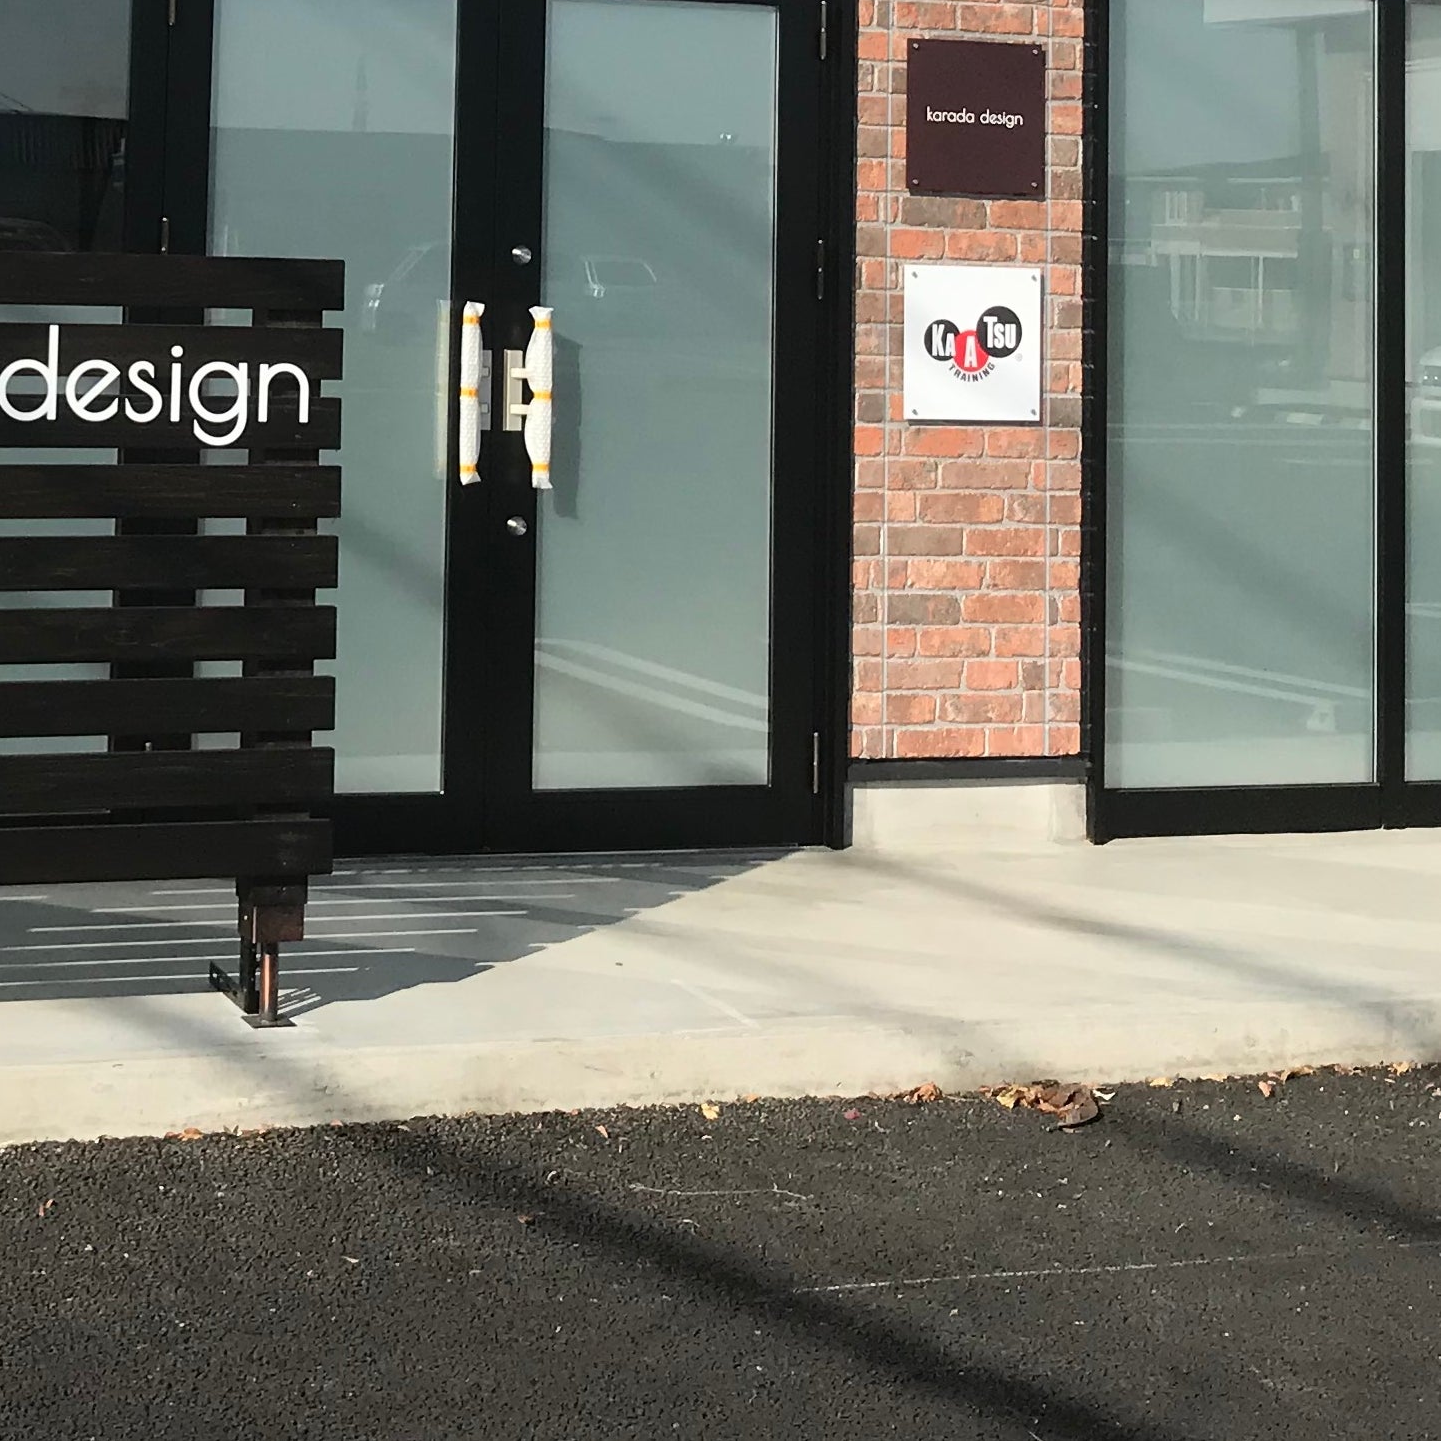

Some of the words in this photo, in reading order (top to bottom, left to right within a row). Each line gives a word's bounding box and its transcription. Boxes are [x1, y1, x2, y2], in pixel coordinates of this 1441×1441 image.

[926, 105, 975, 124] karada
[979, 108, 1024, 129] design
[948, 361, 996, 382] TRAINING
